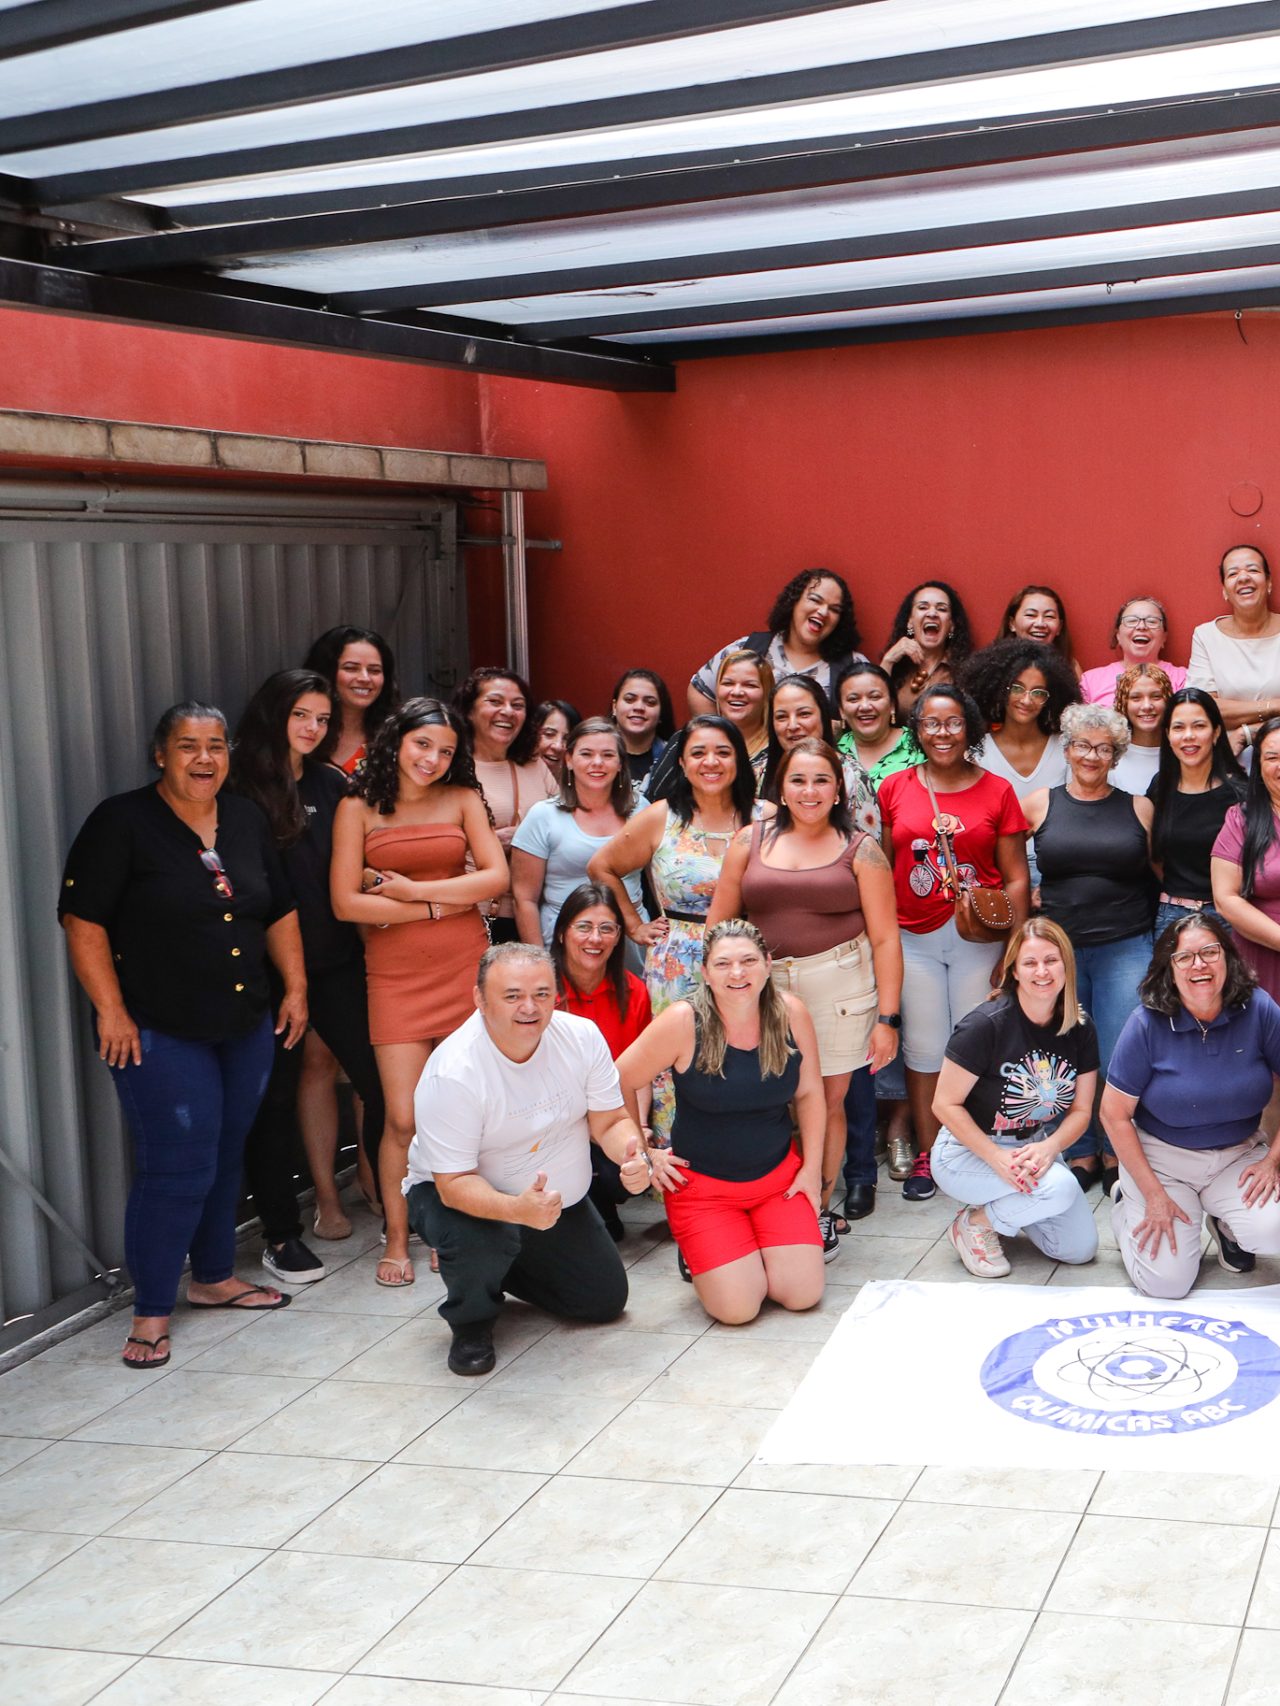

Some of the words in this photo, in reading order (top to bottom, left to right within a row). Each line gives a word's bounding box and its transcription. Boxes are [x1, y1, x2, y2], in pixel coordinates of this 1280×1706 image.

[1046, 1314, 1249, 1343] MULHERES
[1011, 1395, 1174, 1432] QUÍMICAS
[1180, 1398, 1248, 1425] ABC
